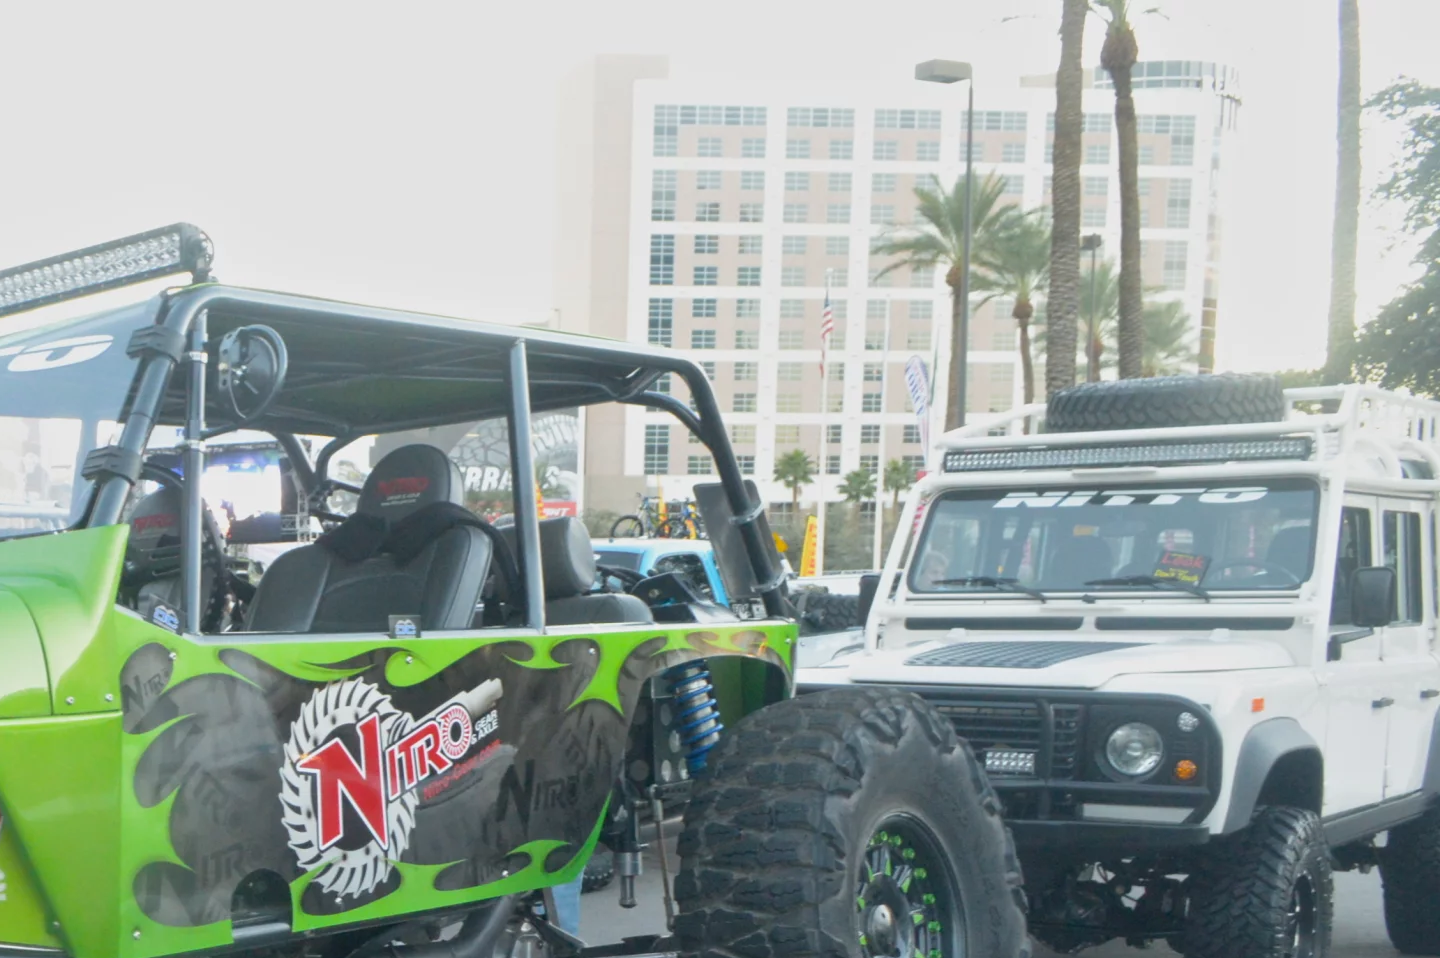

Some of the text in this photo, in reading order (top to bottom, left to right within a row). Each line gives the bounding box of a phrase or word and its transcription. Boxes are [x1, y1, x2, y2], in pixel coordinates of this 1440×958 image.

[992, 487, 1268, 508] NITTO
[475, 709, 498, 731] GEAR
[477, 720, 499, 742] AXLE
[296, 704, 473, 851] NITRO
